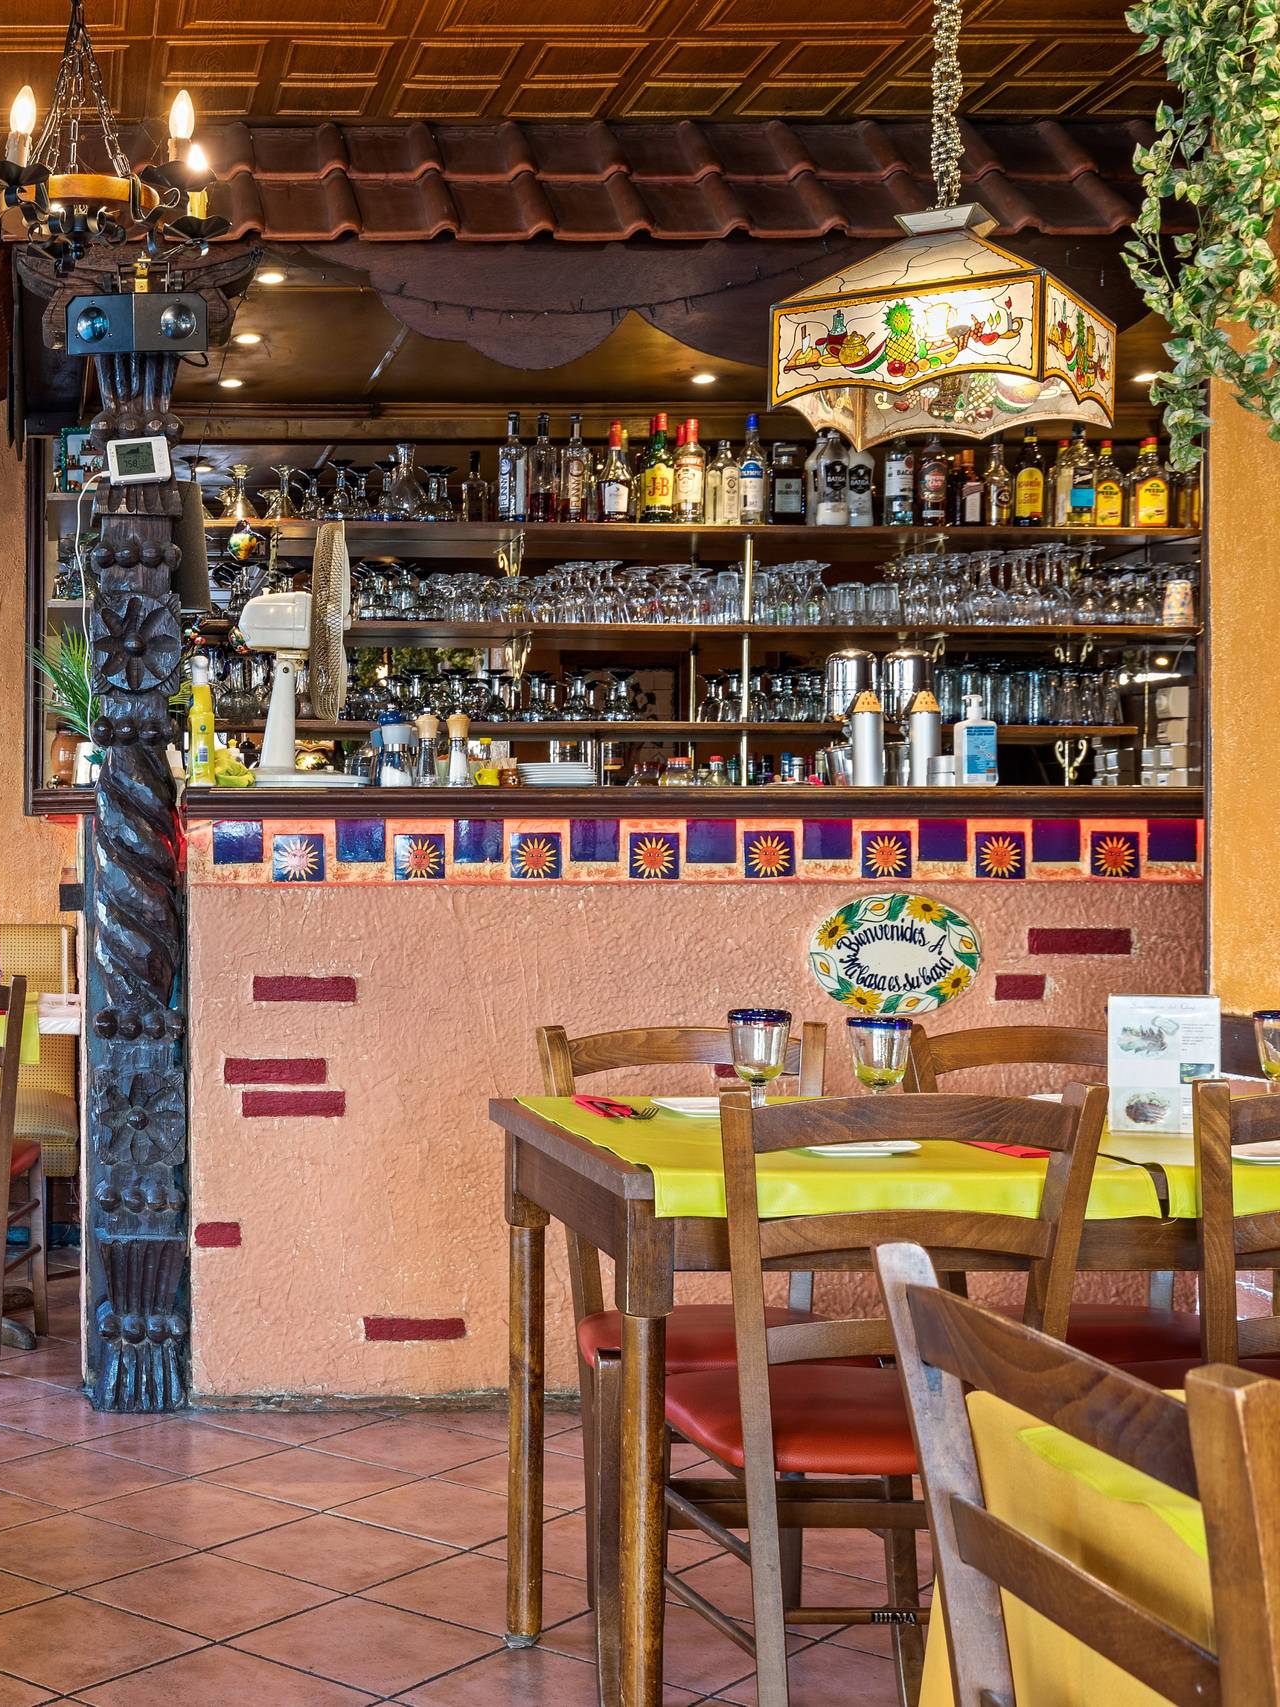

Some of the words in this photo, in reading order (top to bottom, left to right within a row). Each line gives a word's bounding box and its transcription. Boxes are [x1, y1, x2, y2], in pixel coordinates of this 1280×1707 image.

[837, 918, 930, 955] Bienvenidos
[856, 965, 887, 991] Casa
[888, 975, 901, 992] es
[919, 956, 954, 985] Casa
